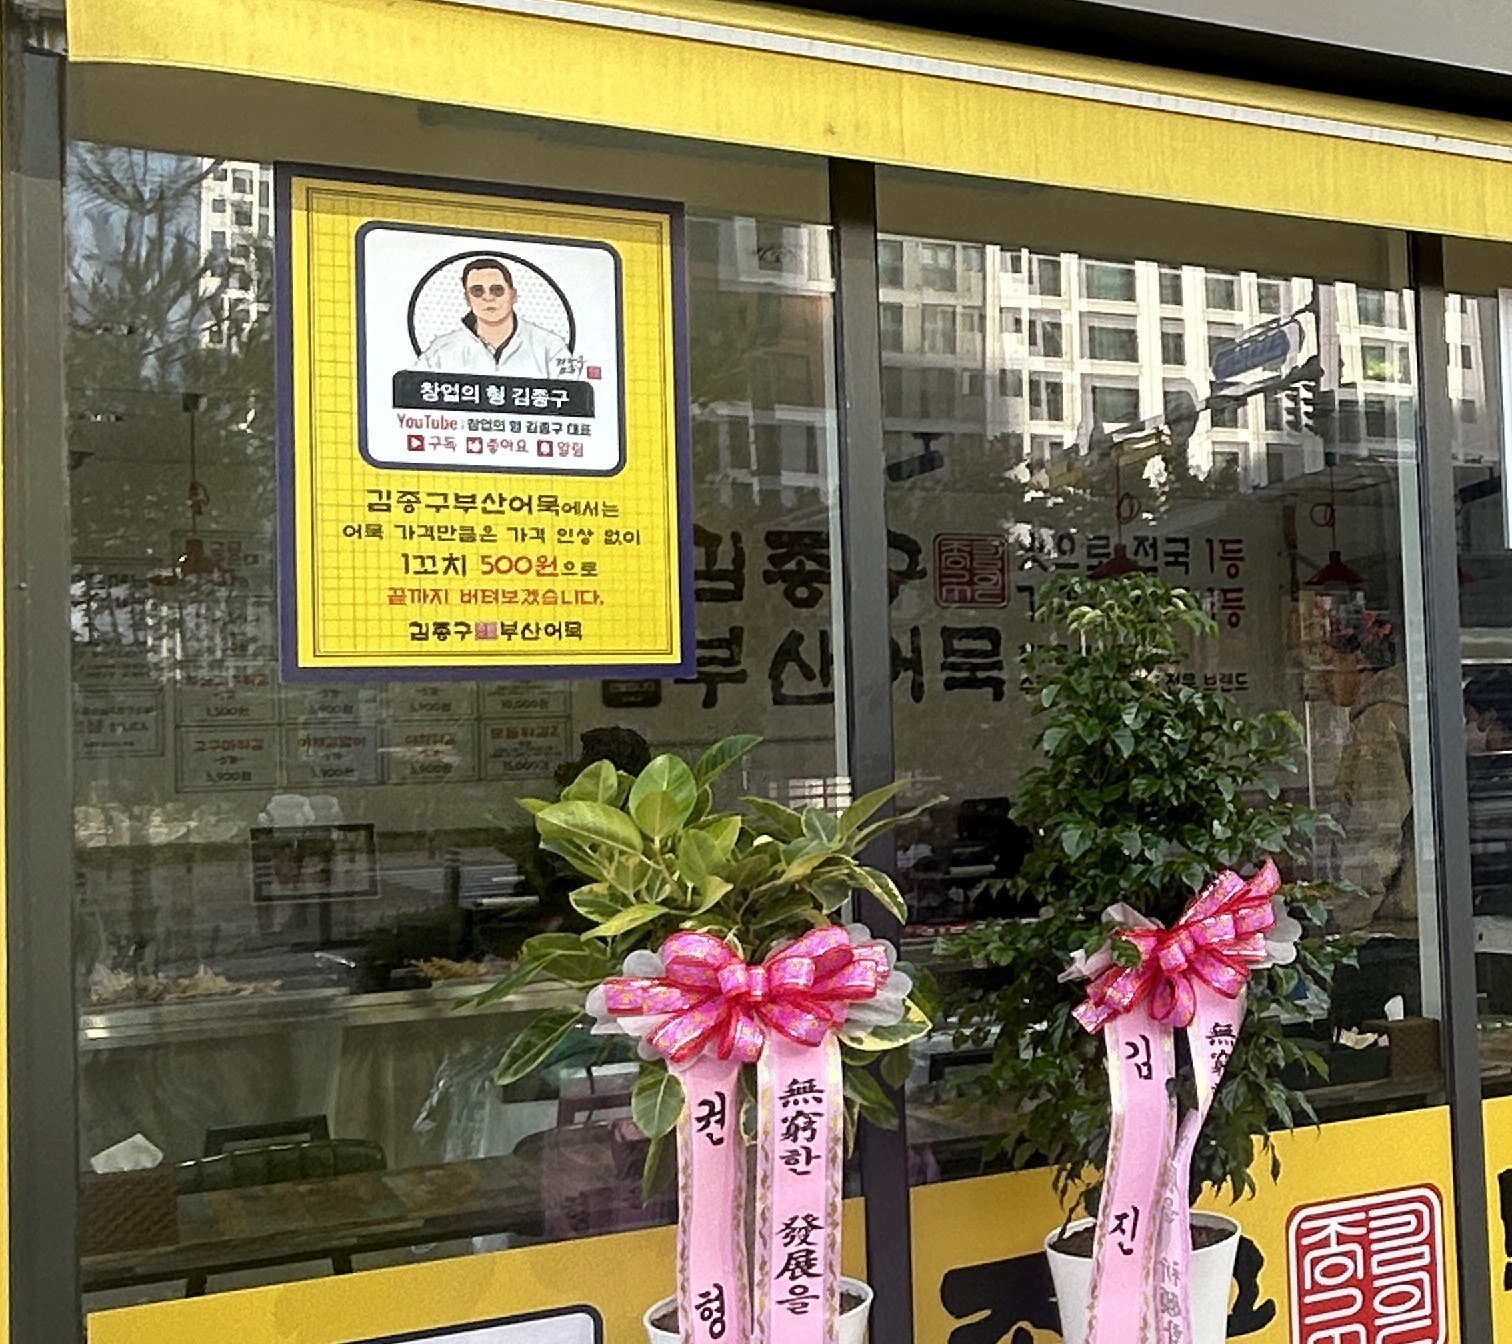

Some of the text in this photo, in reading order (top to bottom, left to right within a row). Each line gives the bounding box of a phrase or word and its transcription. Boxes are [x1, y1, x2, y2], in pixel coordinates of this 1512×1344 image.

[420, 381, 570, 408] 창업의 형 김종구
[396, 413, 458, 431] YouTube
[428, 436, 457, 452] 구독
[366, 488, 619, 519] 김종구부산어묵에서는
[342, 522, 641, 547] 어묵 가격만큼은 가격 인상 없이
[400, 552, 598, 578] 1꼬치 500원으로
[1205, 536, 1246, 580] 1등
[387, 586, 606, 607] 끝까지 버텨보겠습니다.
[409, 620, 583, 642] 김종구 부산어묵
